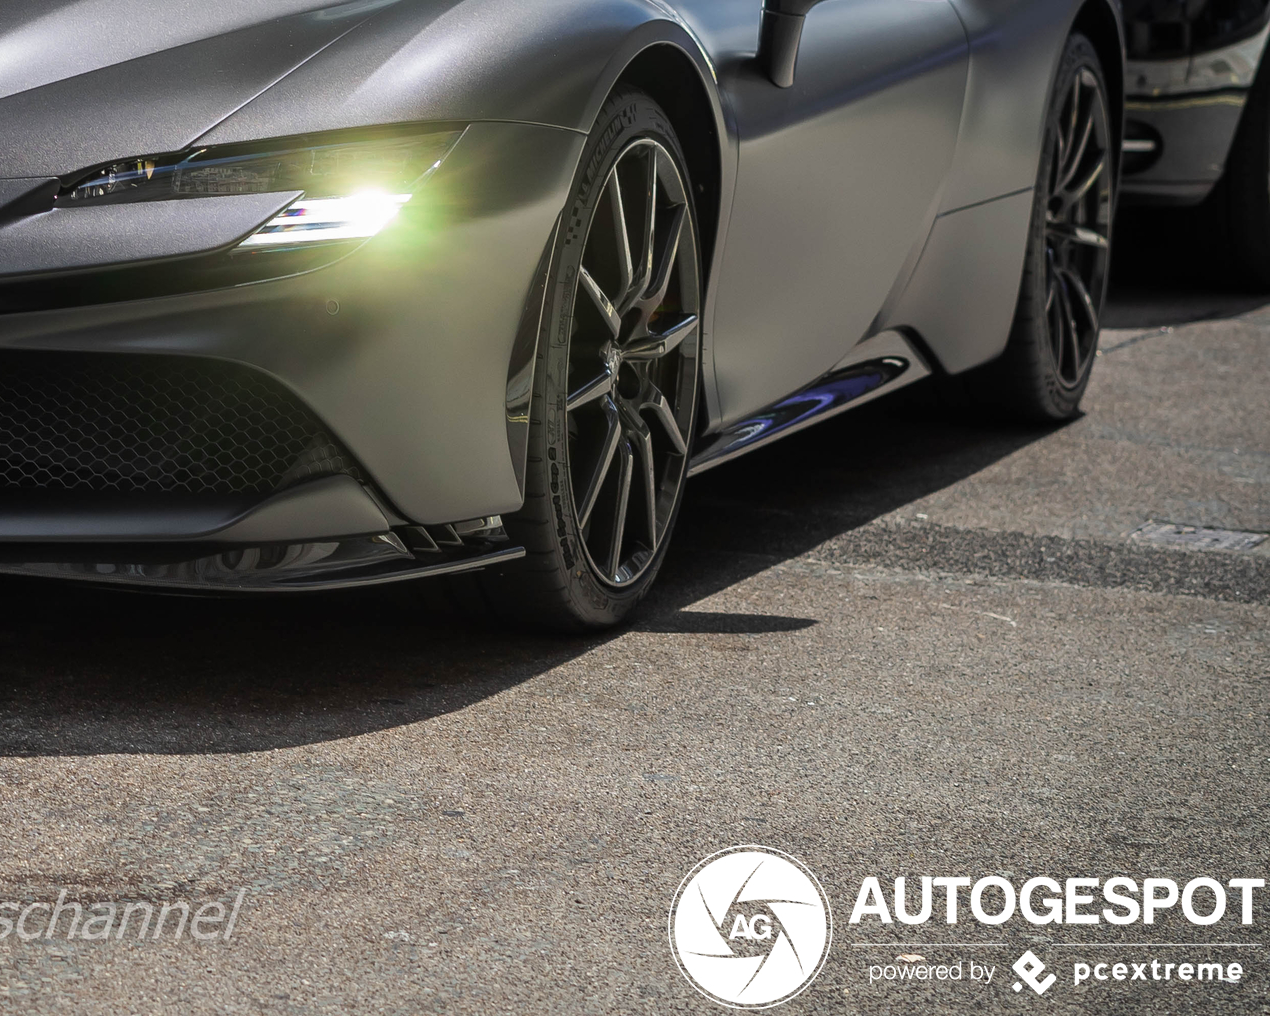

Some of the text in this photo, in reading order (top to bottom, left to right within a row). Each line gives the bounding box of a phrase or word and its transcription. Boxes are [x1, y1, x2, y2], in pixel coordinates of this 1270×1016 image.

[586, 113, 626, 185] MICHELIN
[548, 447, 557, 461] 2
[550, 462, 559, 494] Cup
[552, 495, 567, 538] Sport
[559, 536, 575, 571] Pilot
